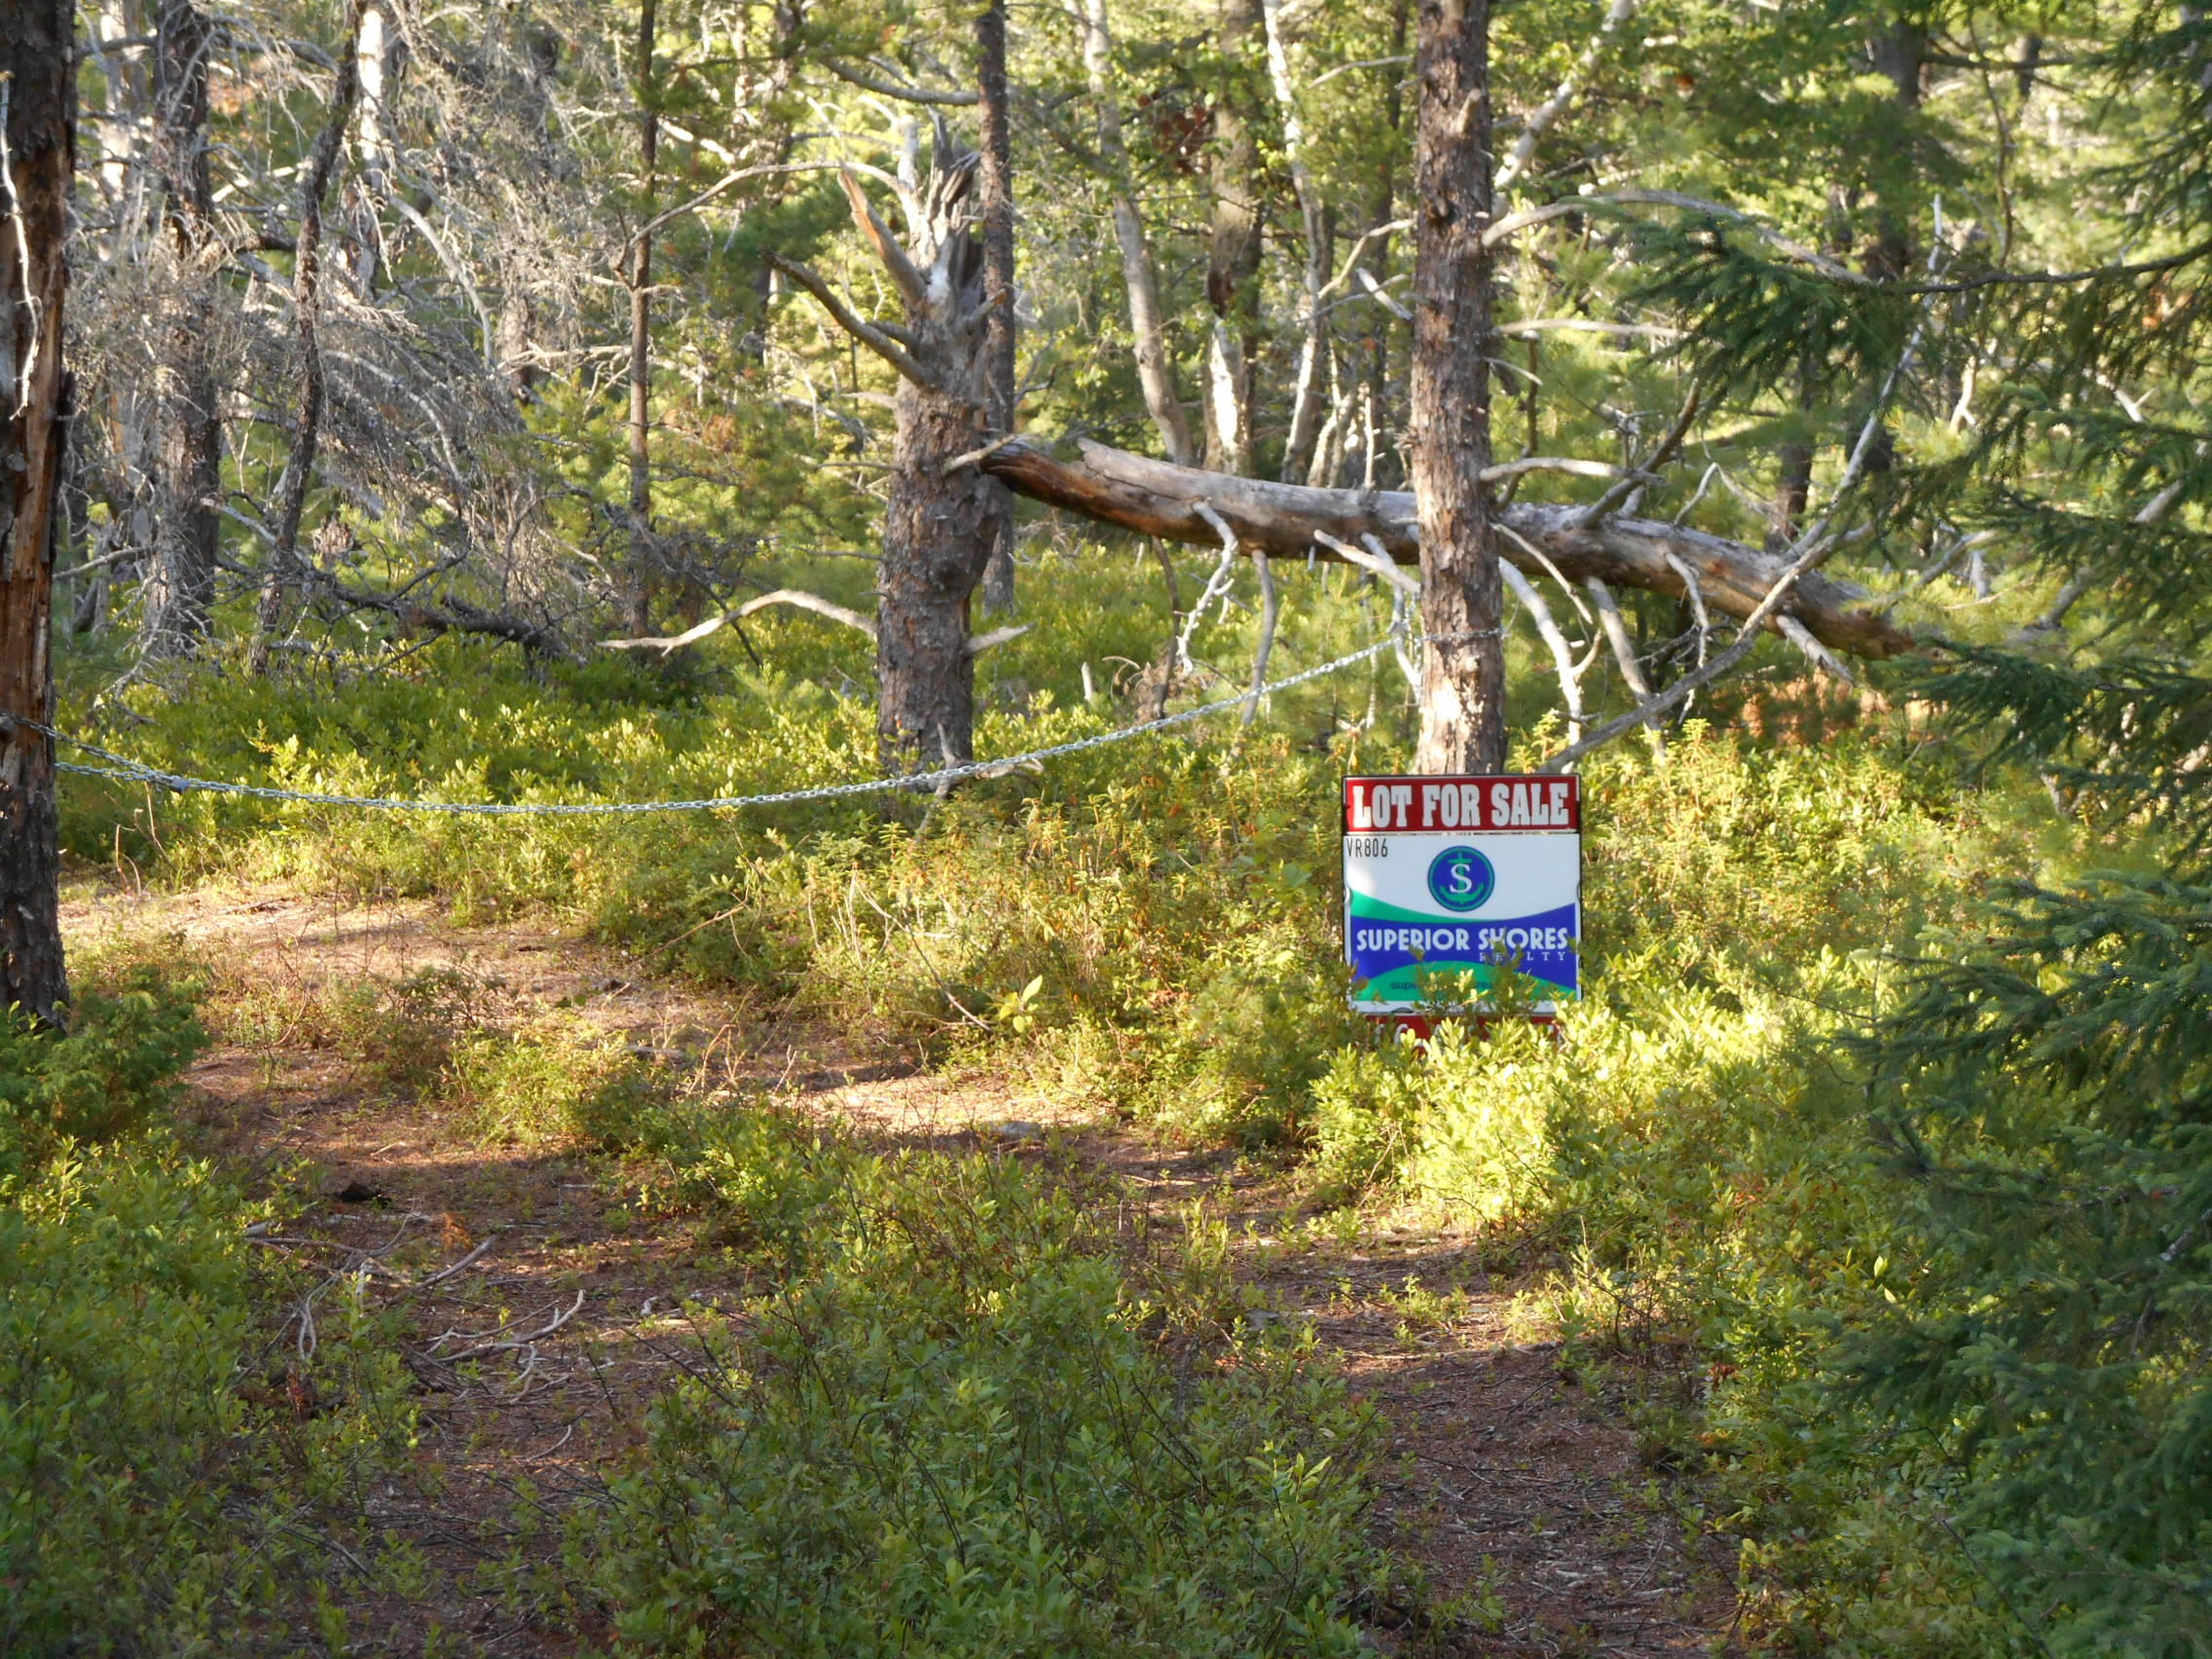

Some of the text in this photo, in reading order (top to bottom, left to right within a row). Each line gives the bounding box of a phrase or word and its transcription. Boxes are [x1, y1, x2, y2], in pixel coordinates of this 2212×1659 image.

[1352, 782, 1569, 829] LOT FOR SALE
[1346, 837, 1389, 858] VR806
[1449, 863, 1473, 895] S
[1356, 927, 1568, 952] SUPERIOR SHORES
